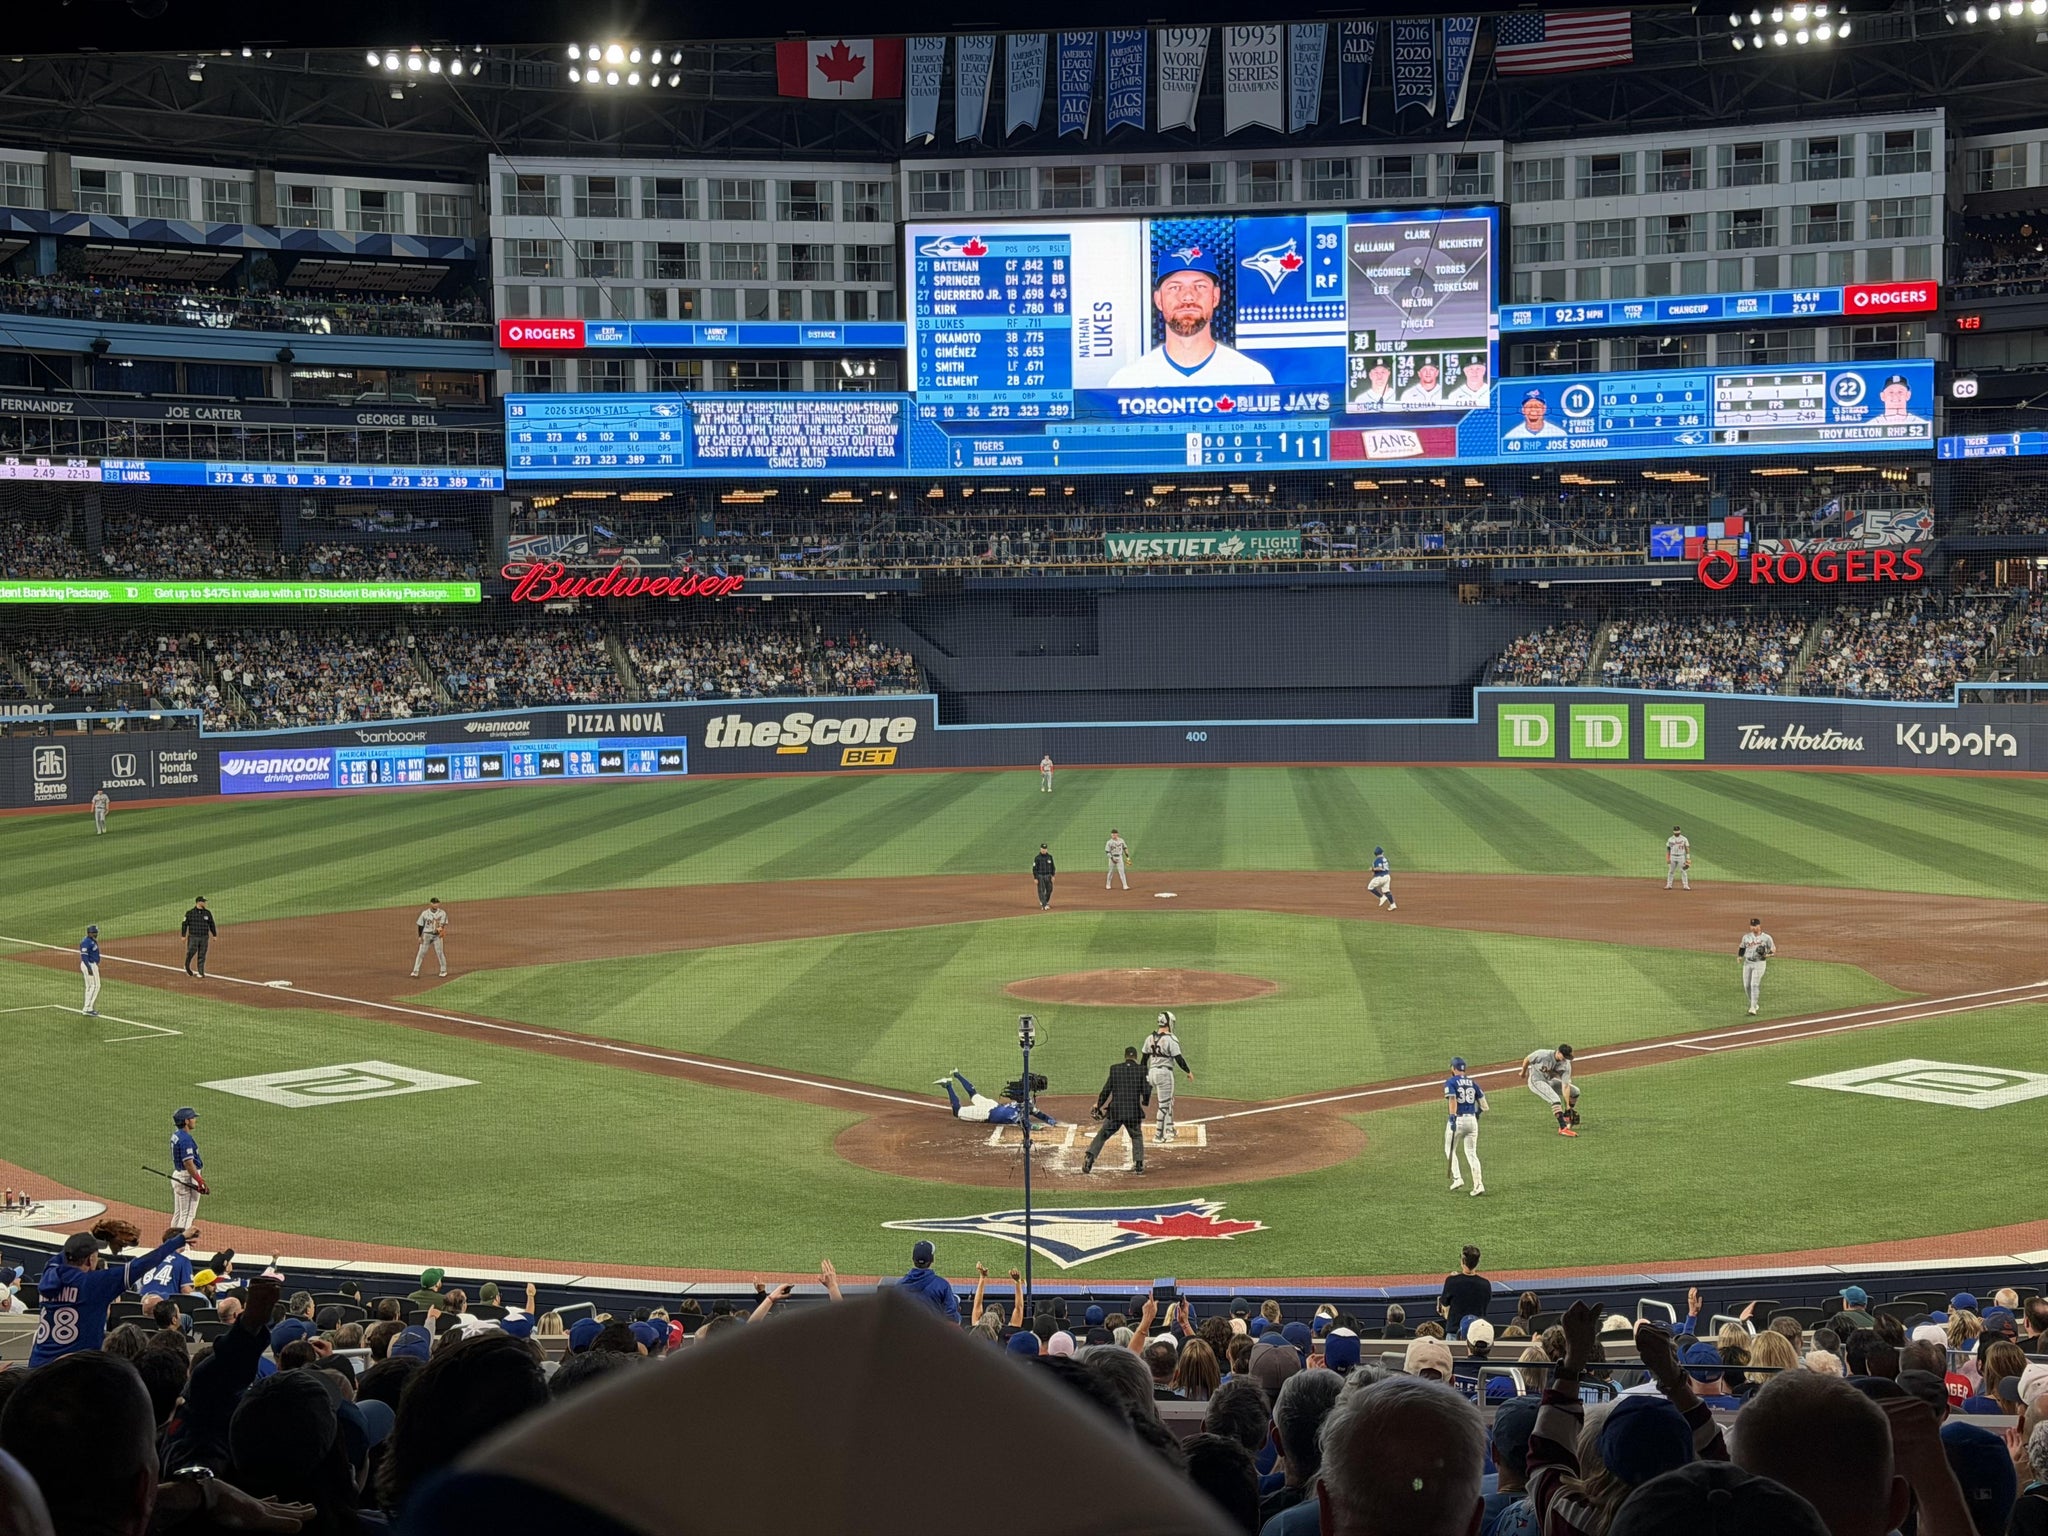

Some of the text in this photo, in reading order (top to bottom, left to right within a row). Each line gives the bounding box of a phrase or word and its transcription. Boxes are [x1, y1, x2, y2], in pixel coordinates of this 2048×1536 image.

[1344, 22, 1374, 34] 2016
[1397, 27, 1430, 40] 2016
[963, 36, 993, 49] 1989
[1063, 32, 1093, 45] 1992
[1165, 29, 1207, 48] 1992
[1230, 26, 1276, 47] 1993
[1343, 39, 1374, 54] ALDS
[1229, 50, 1278, 66] WORLD
[1395, 47, 1431, 60] 2020
[1110, 54, 1142, 68] LEAGUE
[1111, 64, 1142, 81] EAST
[1228, 66, 1279, 81] SERIES
[1397, 67, 1432, 78] 2022
[1110, 77, 1142, 91] CHAMPS
[1228, 81, 1279, 93] CHAMPIONS
[1398, 84, 1433, 96] 2023
[1110, 93, 1141, 111] ALCS
[1109, 107, 1140, 121] CHAMPS
[1316, 234, 1338, 249] 38
[1404, 230, 1430, 240] CLARK
[1354, 242, 1395, 253] CALLAHAN
[1438, 238, 1484, 249] MCKINSTRY
[933, 261, 979, 272] BATEMAN
[1366, 267, 1411, 278] MCGONIGLE
[1435, 264, 1466, 275] TORRES
[933, 275, 981, 287] SPRINGER
[1316, 275, 1338, 288] RF
[1433, 281, 1479, 293] TORKELSON
[934, 288, 1002, 301] GUERRERO JR.
[1871, 290, 1927, 305] ROGERS
[934, 304, 957, 315] KIRK
[1402, 298, 1433, 308] MELTON
[1668, 304, 1709, 315] CHANGEUP
[1556, 309, 1585, 323] 92.3
[934, 319, 965, 329] LUKES
[1094, 301, 1113, 358] LUKES
[525, 327, 575, 340] ROGERS
[934, 333, 981, 344] OKAMOTO
[1079, 317, 1090, 358] NATHAN
[935, 345, 977, 358] GIMÉNEZ
[935, 362, 965, 372] SMITH
[935, 376, 979, 387] CLEMENT
[1956, 383, 1974, 395] CC
[1, 399, 74, 414] FERNANDEZ
[544, 406, 629, 415] 2026 SEASON STATS
[692, 402, 899, 414] THREW OUT CHRISTIAN ENCARNACION-STRAND
[1118, 397, 1213, 415] TORONTO
[1236, 395, 1281, 412] BLUE
[1283, 393, 1330, 411] JAYS
[165, 406, 242, 420] JOE CARTER
[357, 413, 438, 426] GEORGE BELL
[699, 414, 892, 425] AT HOME IN THE FOURTH INNING SATURDAY
[694, 425, 717, 436] WITH
[718, 425, 726, 436] A
[727, 425, 743, 436] 100
[746, 425, 765, 436] MPH
[804, 425, 822, 436] THE
[824, 425, 864, 436] HARDEST
[866, 425, 899, 436] THROW
[1818, 426, 1923, 439] TROY MELTON 52
[698, 435, 895, 446] OF CAREER AND SECOND HARDEST OUTFIELD
[973, 441, 1004, 451] TIGERS
[1372, 433, 1417, 452] JANES
[1546, 437, 1608, 450] JOSÉ SORIANO
[698, 446, 895, 457] ASSIST BY A BLUE JAY IN THE STATCAST ERA
[769, 457, 826, 469] (SINCE 2015)
[973, 456, 1023, 466] BLUE JAYS
[1251, 537, 1298, 549] FLIGHT
[1751, 548, 1924, 584] ROGERS
[501, 562, 745, 602] Budweiser
[23, 587, 112, 600] Banking Package.
[154, 588, 174, 598] Get
[175, 589, 189, 600] up
[190, 588, 201, 598] to
[203, 588, 229, 599] $475
[243, 589, 269, 598] value
[271, 588, 293, 598] with
[304, 588, 317, 598] TD
[319, 588, 357, 598] Student
[361, 589, 402, 601] Banking
[567, 712, 664, 735] PIZZA NOVA
[704, 712, 917, 748] theScore
[1504, 714, 1549, 746] TD
[1186, 732, 1207, 742] 400
[1576, 714, 1622, 747] TD
[1650, 714, 1698, 748] TD
[1738, 724, 1864, 751] Tim Hortons
[1897, 723, 2017, 756] Kubota
[159, 749, 198, 762] Ontario
[464, 756, 477, 767] SEA
[846, 750, 892, 763] BET
[159, 762, 192, 773] Honda
[102, 778, 146, 789] HONDA
[159, 773, 199, 785] Dealers
[264, 772, 330, 784] driving emotion
[34, 782, 67, 795] Home
[1457, 1087, 1476, 1104] 38
